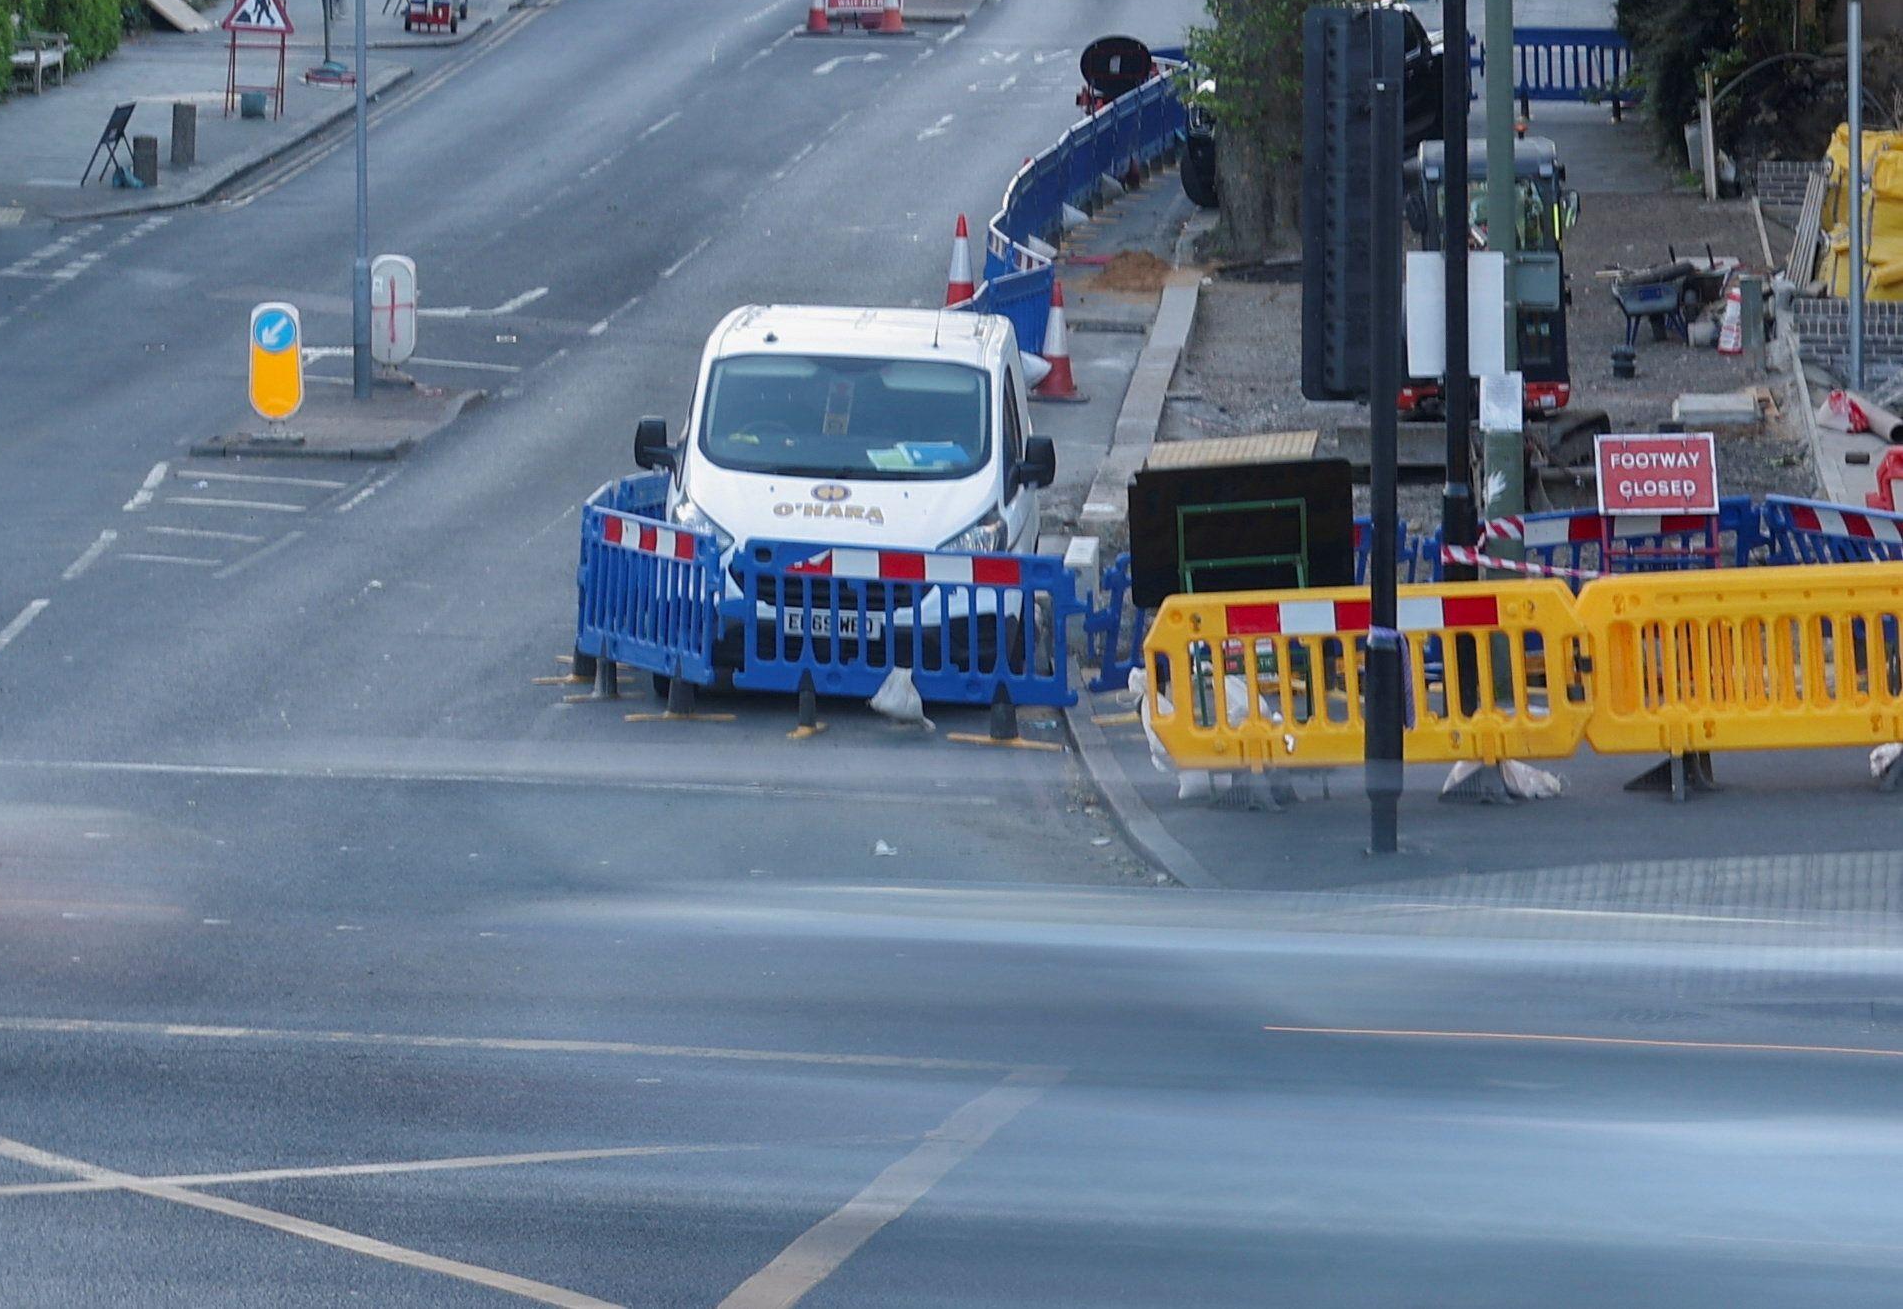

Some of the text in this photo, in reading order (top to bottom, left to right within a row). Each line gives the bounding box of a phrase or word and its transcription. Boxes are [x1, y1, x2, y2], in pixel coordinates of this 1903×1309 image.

[1610, 452, 1700, 469] FOOTWAY
[1619, 479, 1697, 498] CLOSED
[773, 502, 885, 526] O'HARA
